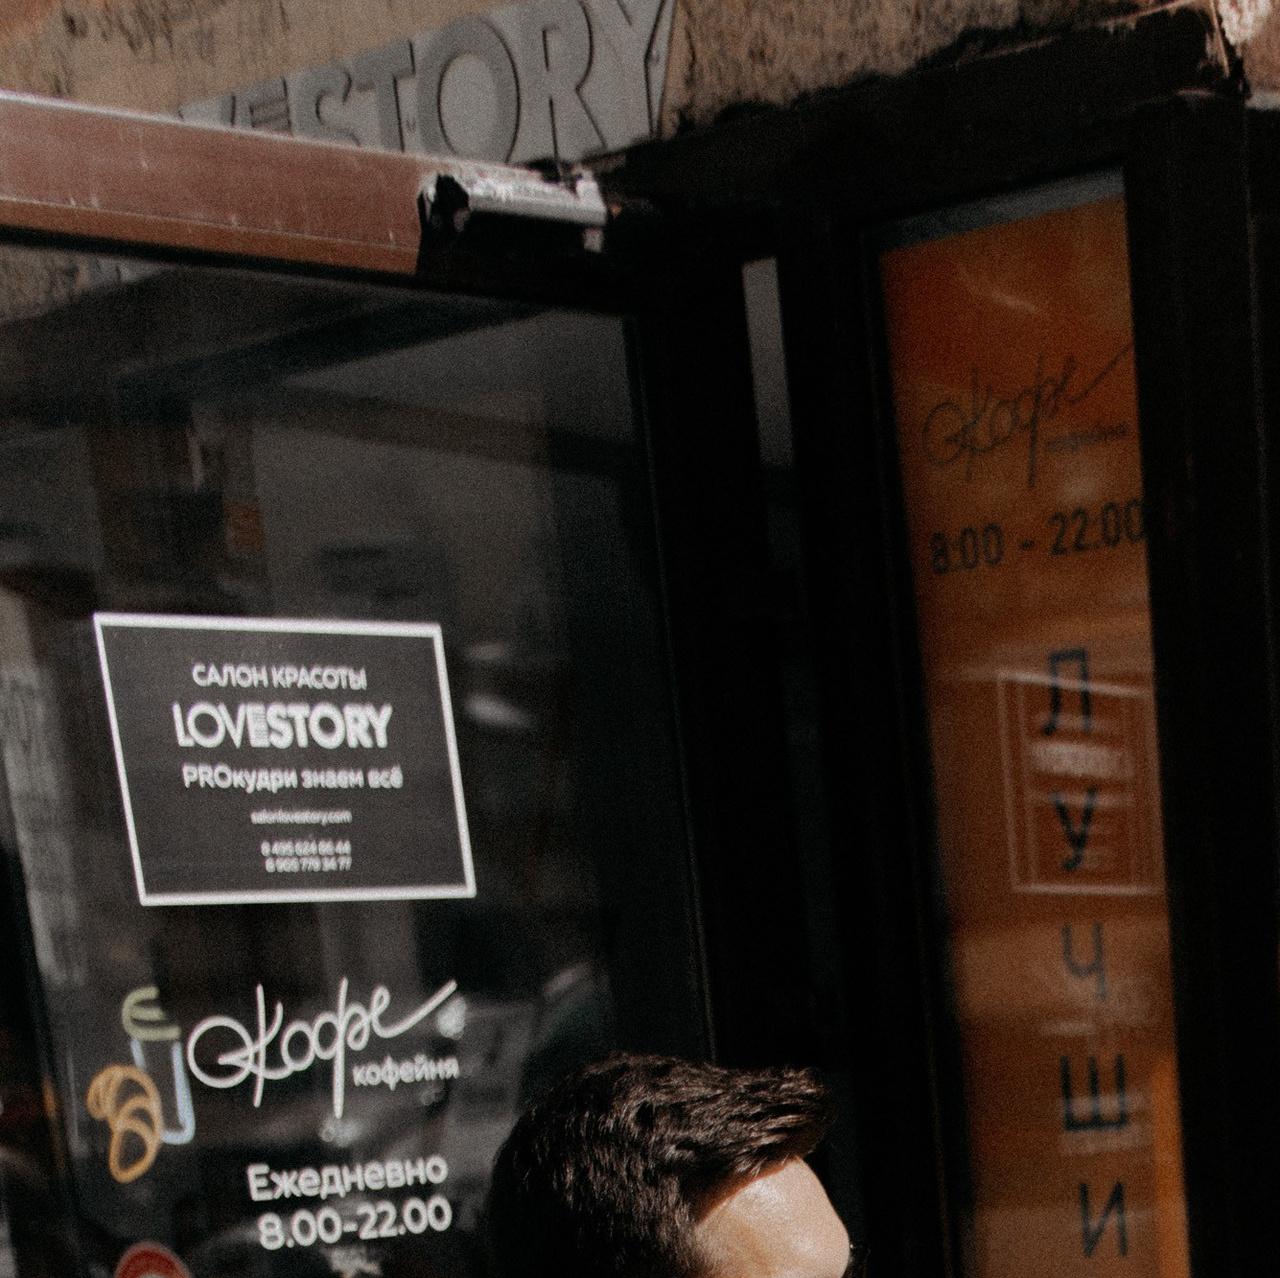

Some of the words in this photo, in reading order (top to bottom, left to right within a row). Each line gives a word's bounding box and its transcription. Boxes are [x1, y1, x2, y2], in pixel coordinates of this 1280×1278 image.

[192, 664, 268, 688] САЛОН
[271, 665, 367, 690] КРАСОТЫ
[172, 702, 393, 749] LOVESTORY
[182, 762, 299, 794] PROкудри
[301, 767, 365, 789] знаем
[187, 977, 458, 1119] Кофе
[353, 1054, 459, 1090] кофейня
[247, 1155, 448, 1202] Ежедневно
[257, 1196, 452, 1250] 8.00-22.00
